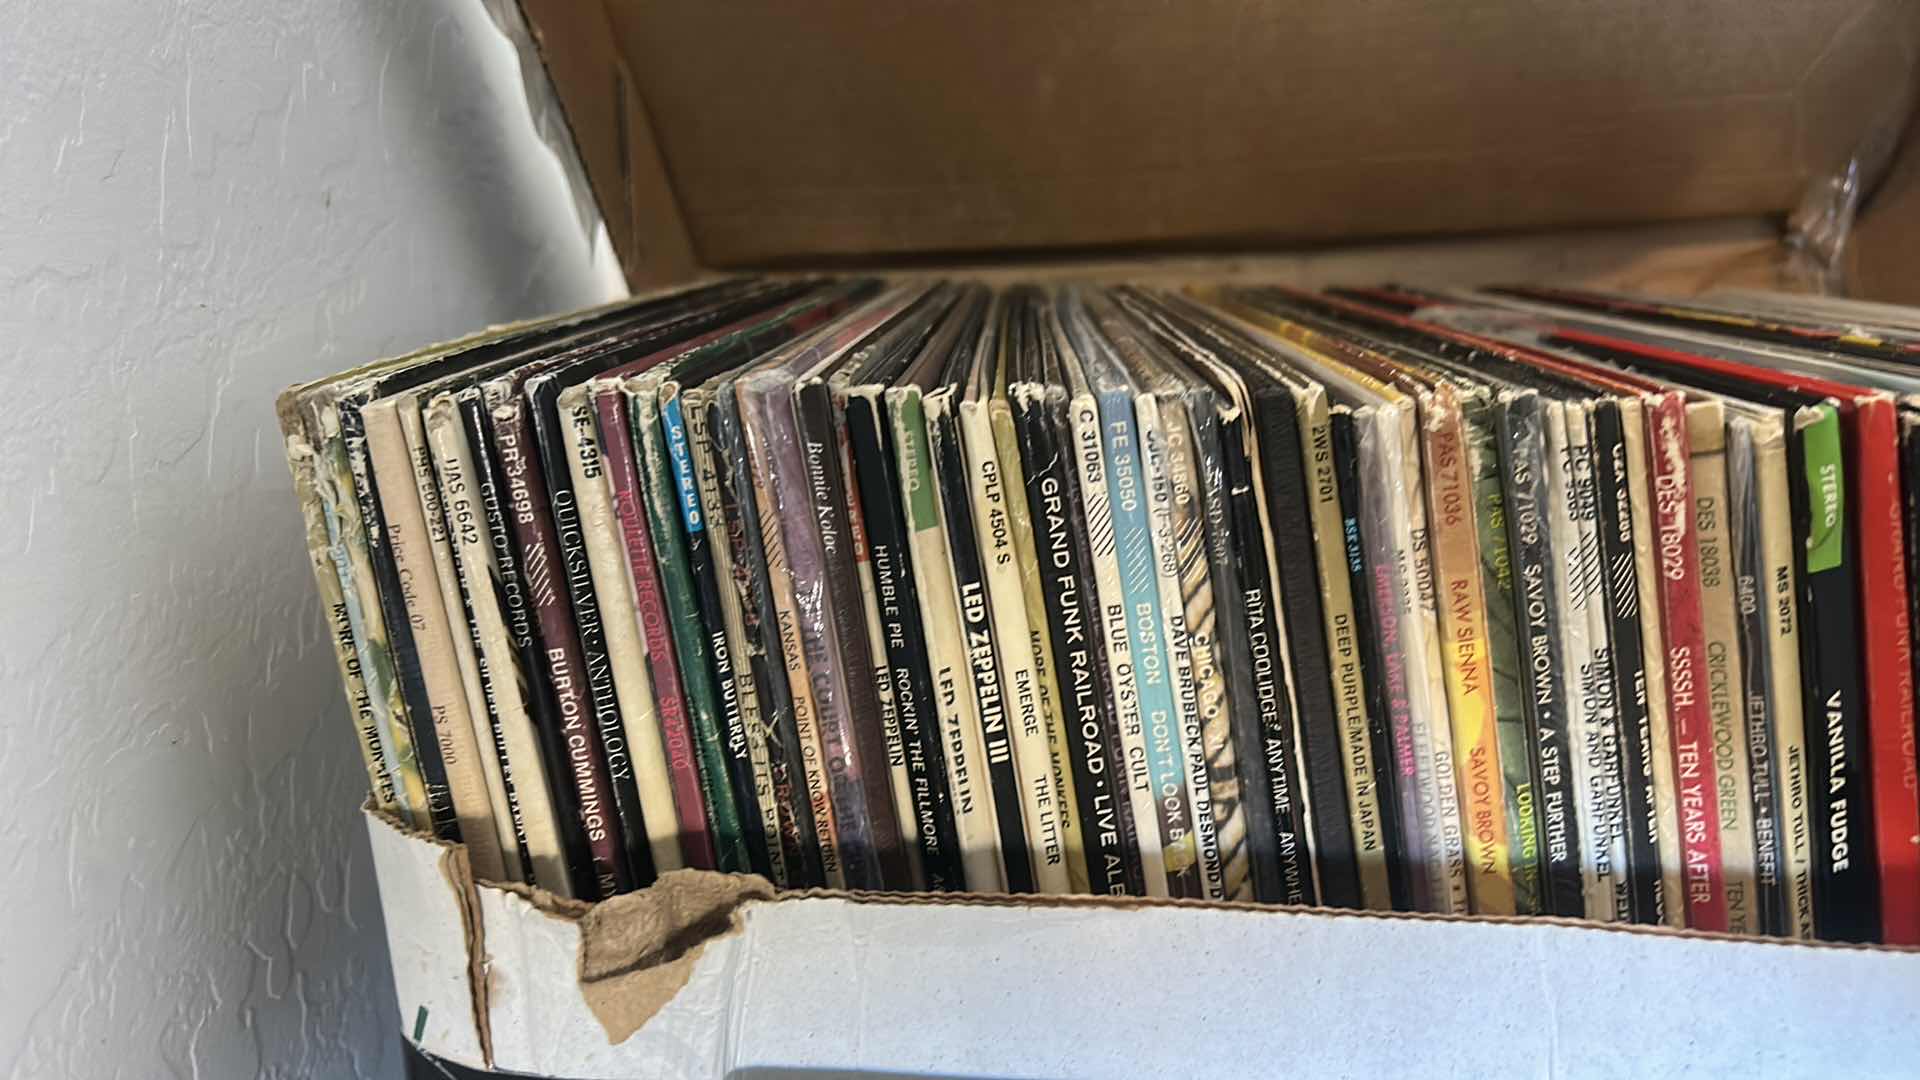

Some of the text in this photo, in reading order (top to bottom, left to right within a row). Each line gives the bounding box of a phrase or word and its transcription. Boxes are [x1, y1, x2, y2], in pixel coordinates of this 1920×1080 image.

[570, 405, 602, 479] SE-4315
[1080, 409, 1094, 423] C
[1110, 421, 1129, 449] FE
[1311, 424, 1329, 462] 2WS
[445, 459, 466, 494] UAS
[1081, 431, 1102, 483] 31063
[1114, 454, 1137, 513] 35050
[1318, 467, 1333, 504] 2701
[1572, 445, 1590, 472] PC
[455, 500, 479, 545] 6642
[807, 442, 839, 555] Bonnie Koloc
[1040, 477, 1071, 568] GRAND
[481, 482, 533, 648] GUSTO RECORDS
[1167, 421, 1181, 448] JC
[1194, 632, 1218, 720] CHICAGO
[1410, 528, 1428, 553] DS
[671, 426, 749, 760] STEREO IRON BUTTERFLY
[874, 544, 898, 616] HUMBLE
[1057, 575, 1084, 644] FUNK
[1522, 563, 1546, 627] SAVOY
[1776, 566, 1790, 593] MS
[389, 524, 457, 765] Price Code 07 PS 7000
[500, 434, 607, 841] PR 34698 BURTON CUMMINGS
[552, 490, 630, 780] QUICKSILVER ANTHOLOGY
[638, 580, 666, 662] RECORDS
[778, 609, 800, 672] KANSAS
[888, 622, 904, 649] PIE
[1107, 604, 1128, 653] BLUE
[1136, 602, 1160, 685] BOSTON
[1334, 613, 1352, 657] DEEP
[1778, 598, 1793, 637] 2072
[346, 659, 362, 679] OF
[961, 582, 1010, 764] LED ZEPPELIN III
[982, 461, 1061, 866] CPLP 4504 S EMERGE THE LITTER
[1385, 651, 1404, 695] LAKE
[1439, 431, 1497, 875] PAS 71036 RAW SIENNA SAVOY BROWN
[1530, 635, 1552, 705] BROWN
[1594, 648, 1614, 709] SIMON
[1819, 464, 1849, 873] STEREO VANILLA FUDGE
[794, 696, 813, 741] POINT
[874, 664, 904, 767] LED ZEPPELIN
[896, 667, 919, 735] ROCKIN'
[1069, 649, 1104, 774] RAILROAD
[1245, 588, 1265, 629] RITA
[1264, 738, 1290, 814] ANYTIME
[1656, 474, 1711, 903] DES 18029 SSSSH. TEN YEARS AFTER
[1696, 496, 1744, 912] DES 18038 CRICKLEWOOD GREEN TEN
[802, 746, 817, 766] OF
[909, 740, 926, 772] THE
[1170, 615, 1190, 660] DAVE
[1199, 800, 1220, 881] DESMOND
[1394, 713, 1416, 777] PALMER
[1539, 727, 1555, 742] A
[1749, 691, 1768, 757] JETHRO
[807, 769, 828, 816] KNOW
[1129, 746, 1150, 792] CULT
[1161, 772, 1182, 823] LOOK
[1356, 781, 1371, 796] IN
[1434, 751, 1456, 817] GOLDEN
[1541, 746, 1561, 785] STEP
[1580, 664, 1611, 883] SIMON AND GARFUNKEL
[1601, 734, 1625, 845] GARFUNKEL
[1752, 762, 1771, 803] TULL
[1788, 744, 1804, 809] JETHRO
[914, 778, 940, 856] FILLMORE
[1094, 793, 1118, 847] LIVE
[1359, 801, 1377, 851] JAPAN
[1515, 782, 1537, 860] LOOKING
[1545, 791, 1567, 863] FURTHER
[1793, 812, 1806, 856] TULL
[1443, 824, 1463, 879] GRASS
[1756, 817, 1776, 886] BENEFIT
[1796, 868, 1811, 919] THICK
